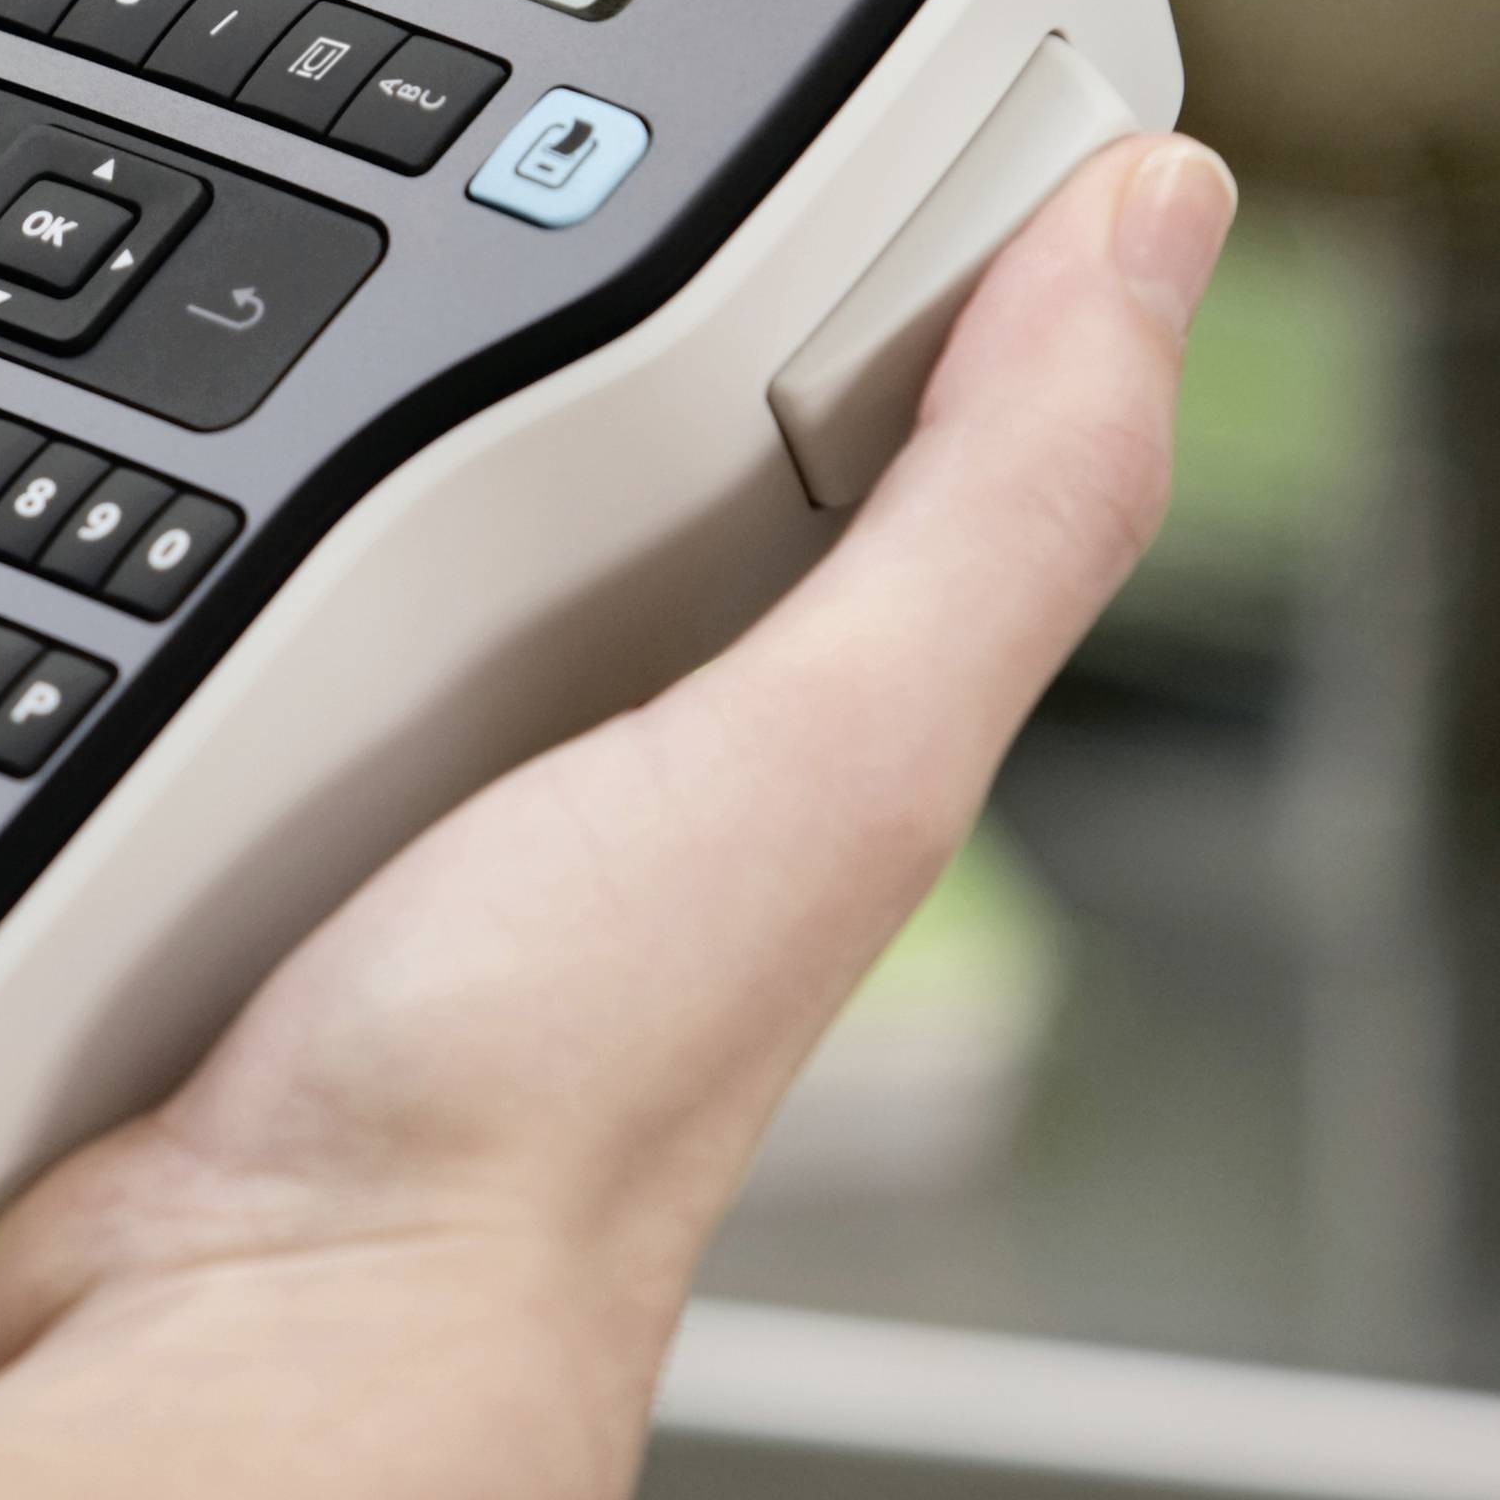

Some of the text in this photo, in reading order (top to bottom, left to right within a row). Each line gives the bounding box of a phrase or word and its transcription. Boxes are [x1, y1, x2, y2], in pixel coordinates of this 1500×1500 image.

[21, 209, 79, 247] OK
[14, 477, 57, 518] 8
[77, 502, 122, 541] 9
[147, 528, 191, 570] 0
[11, 681, 61, 723] P
